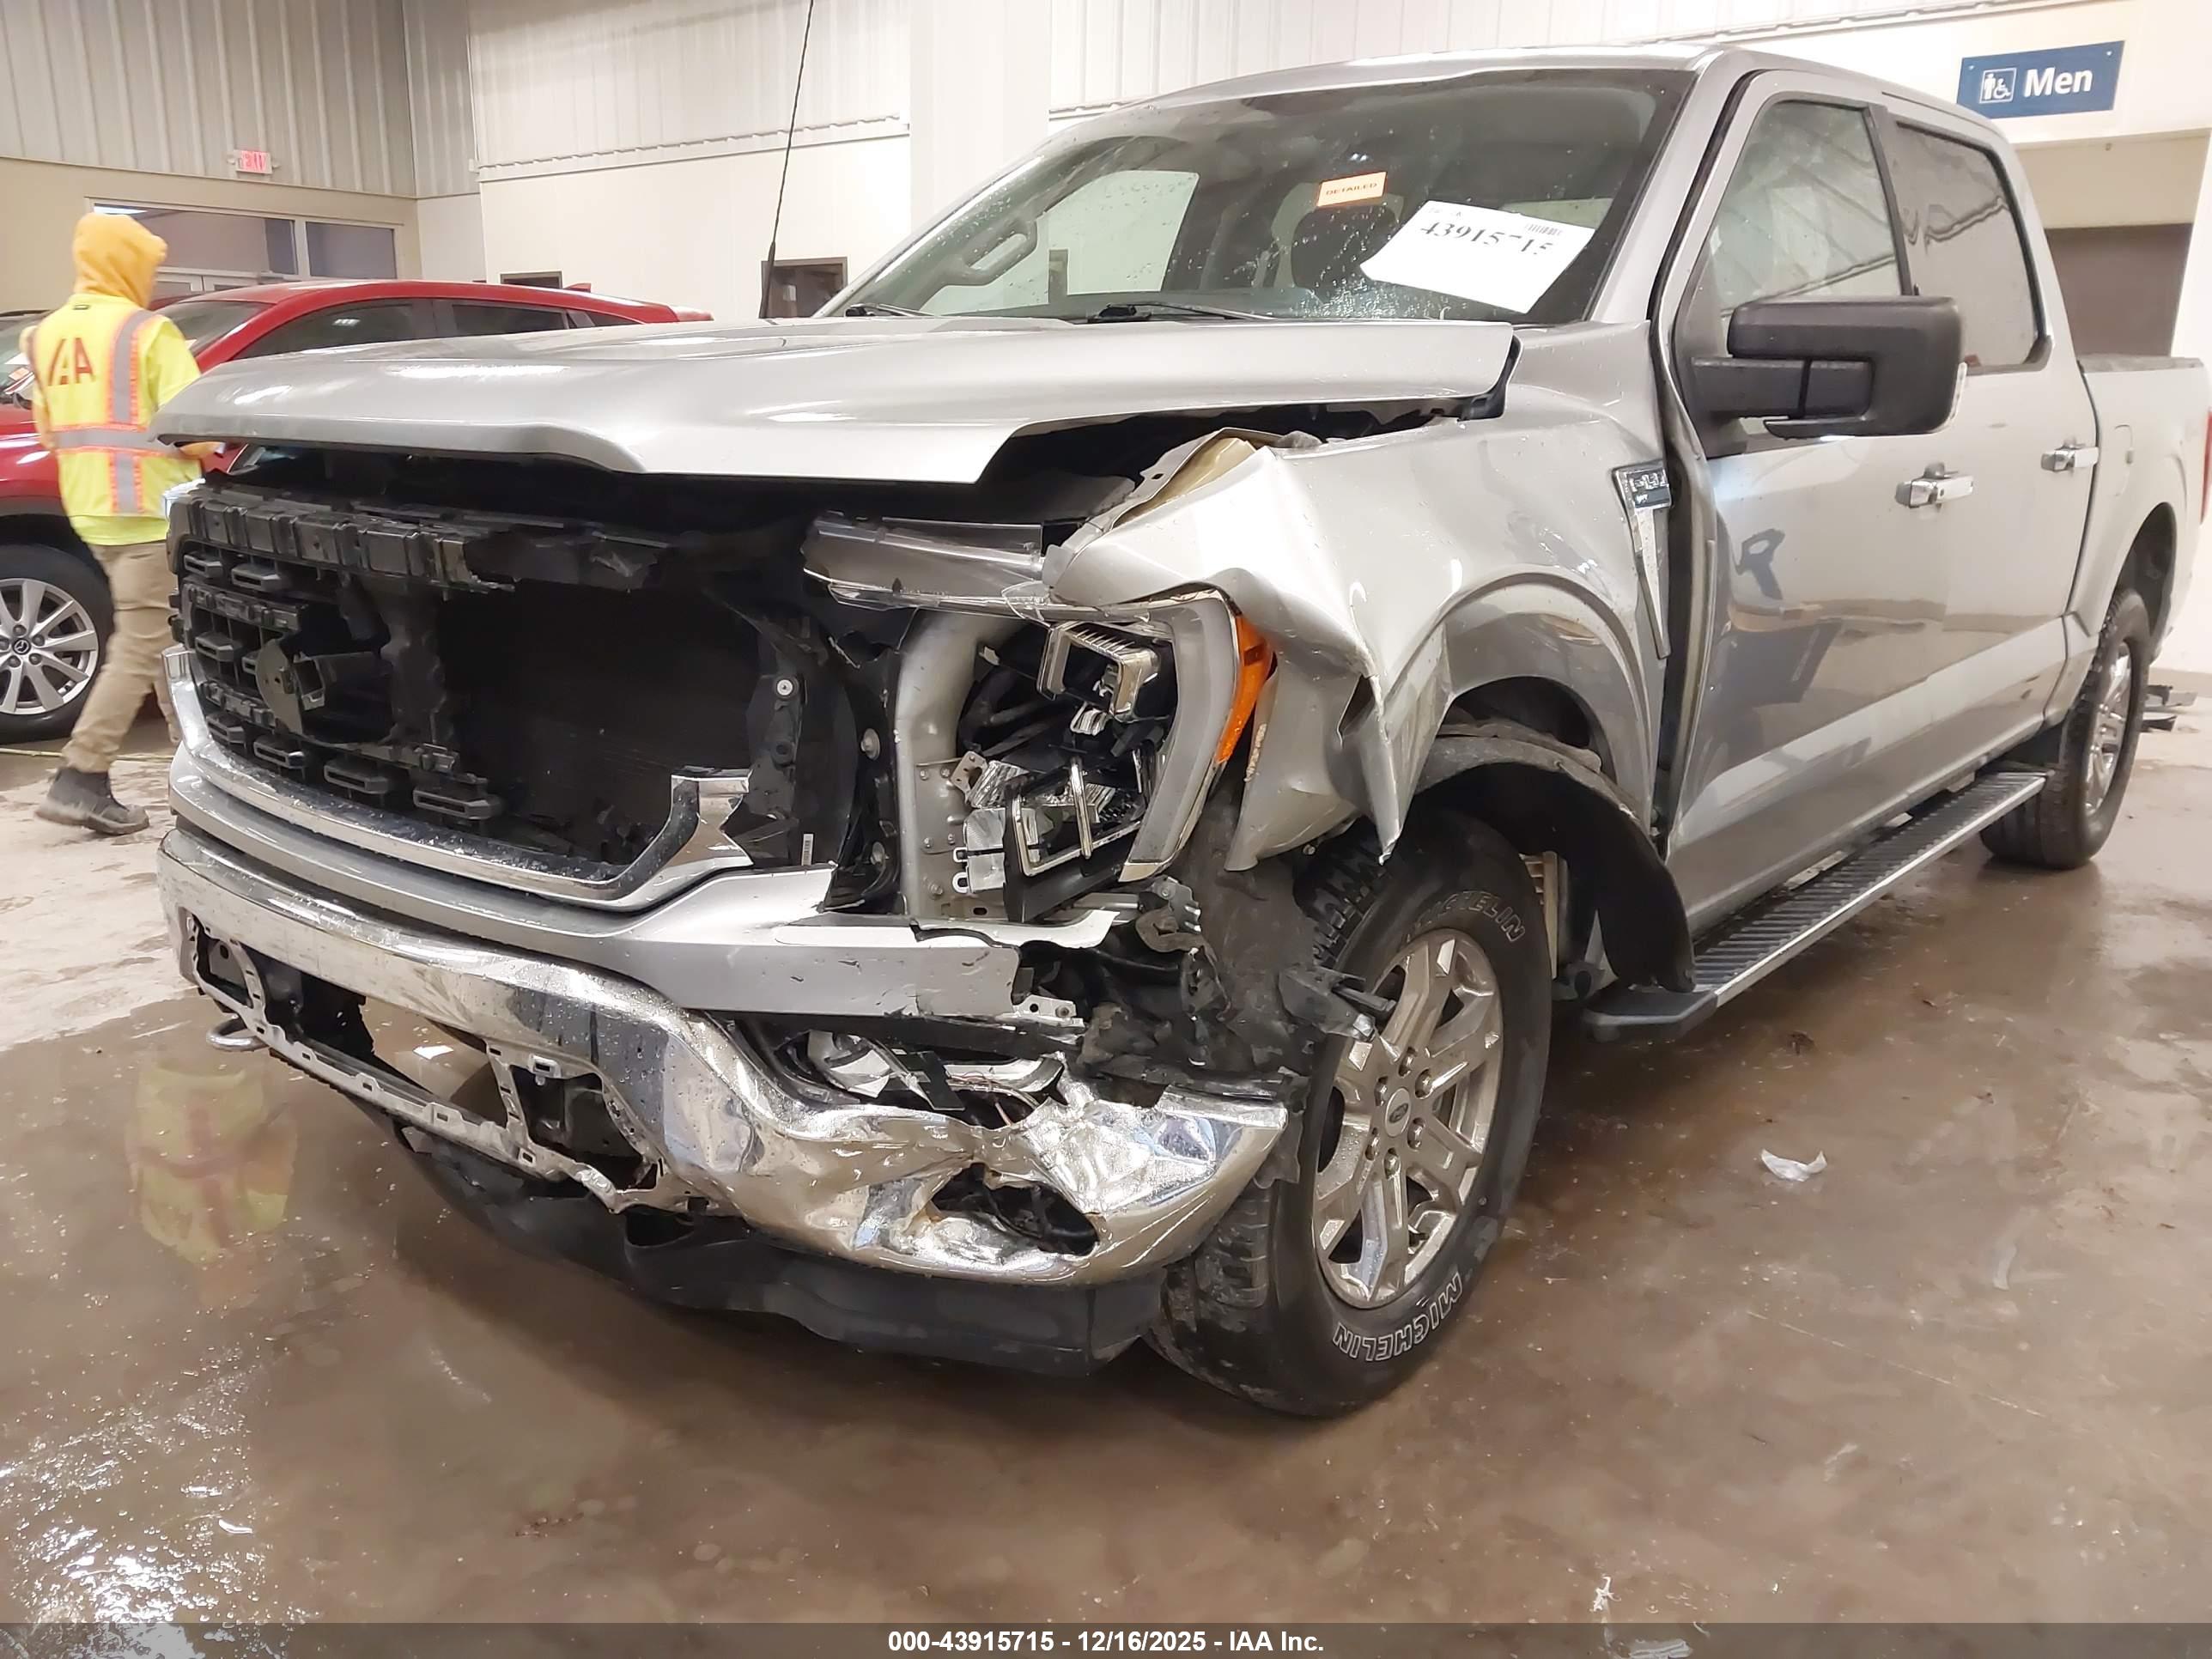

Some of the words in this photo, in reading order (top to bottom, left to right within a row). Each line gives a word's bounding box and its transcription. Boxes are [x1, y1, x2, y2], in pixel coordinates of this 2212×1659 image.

[2024, 66, 2094, 98] Men
[1325, 181, 1378, 197] DETAILED
[1332, 1271, 1463, 1362] MICHELIN
